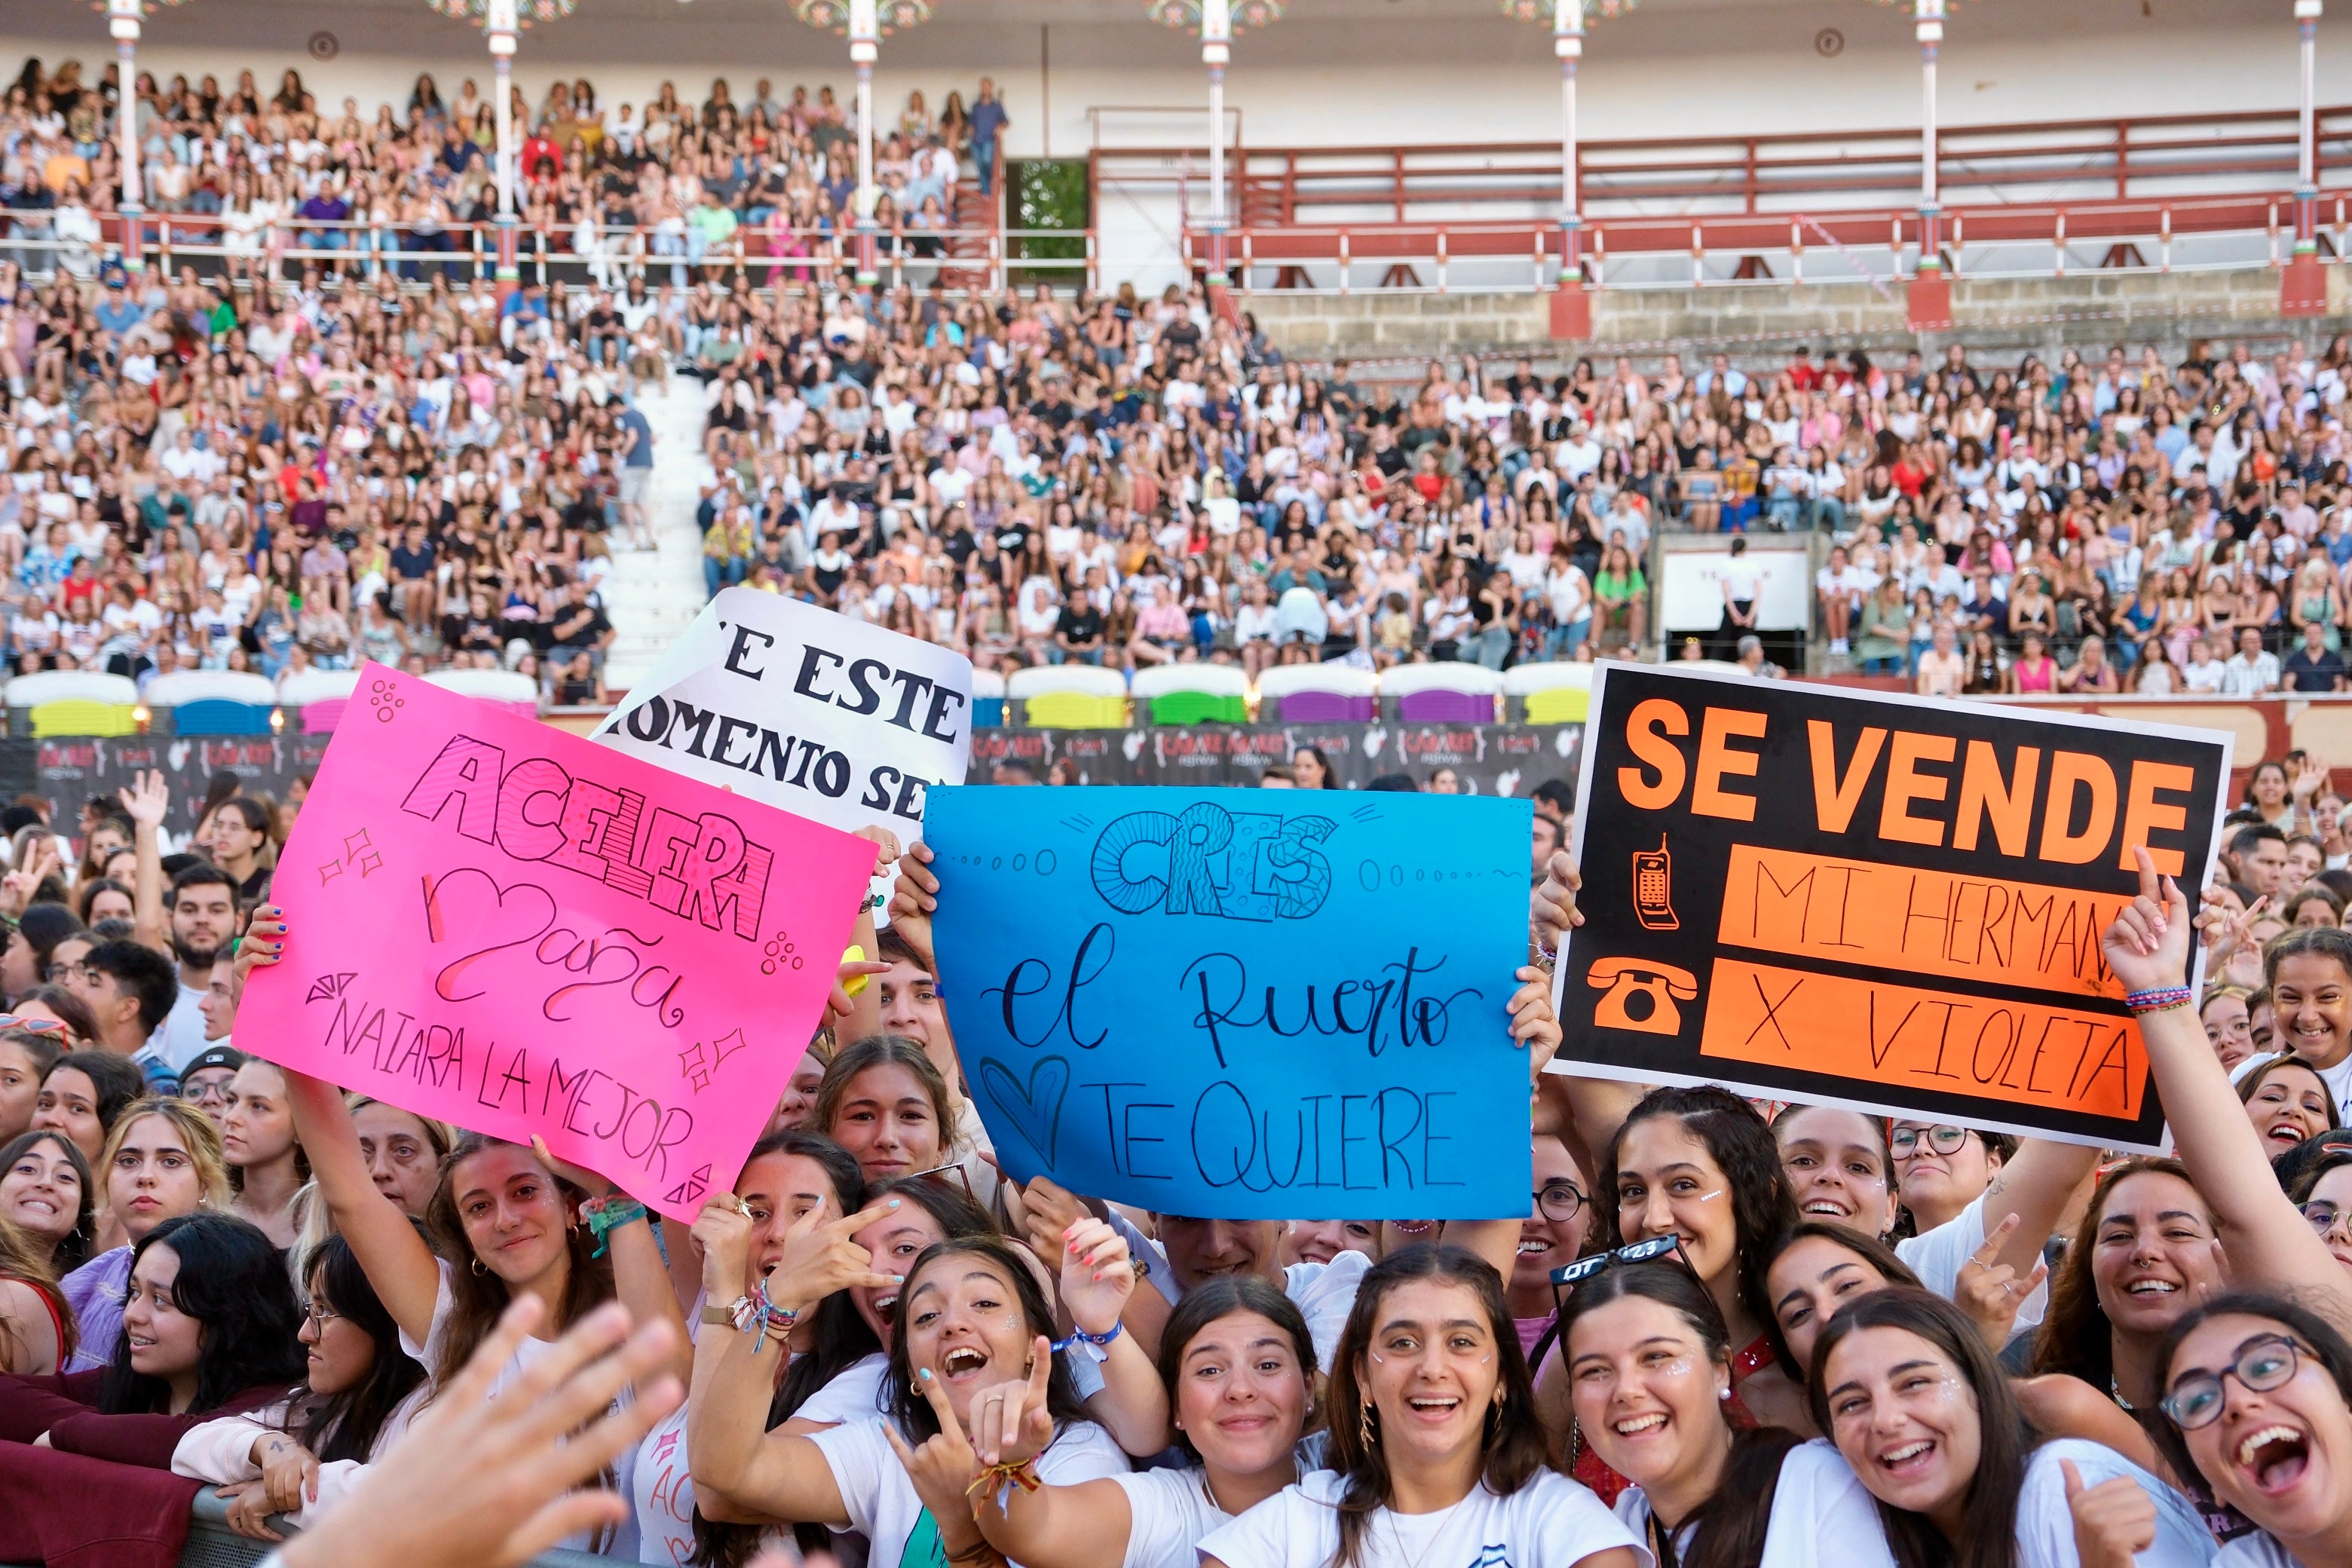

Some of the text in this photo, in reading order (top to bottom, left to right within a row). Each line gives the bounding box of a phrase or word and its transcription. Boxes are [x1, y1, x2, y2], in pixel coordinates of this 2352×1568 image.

[719, 621, 964, 744] E ESTE
[400, 734, 774, 942] ACELERA
[861, 765, 948, 822] SE
[1618, 699, 2194, 877] SE VENDE
[1091, 801, 1339, 922] CRIS
[1753, 861, 2123, 982] MI HERMAN
[422, 868, 684, 1028] Maña
[981, 923, 1483, 1069] el Puerto
[325, 998, 693, 1182] NAIARA LA MEJOR
[1745, 974, 2128, 1110] X VIOLETA
[1080, 1081, 1465, 1193] TE QUIERE
